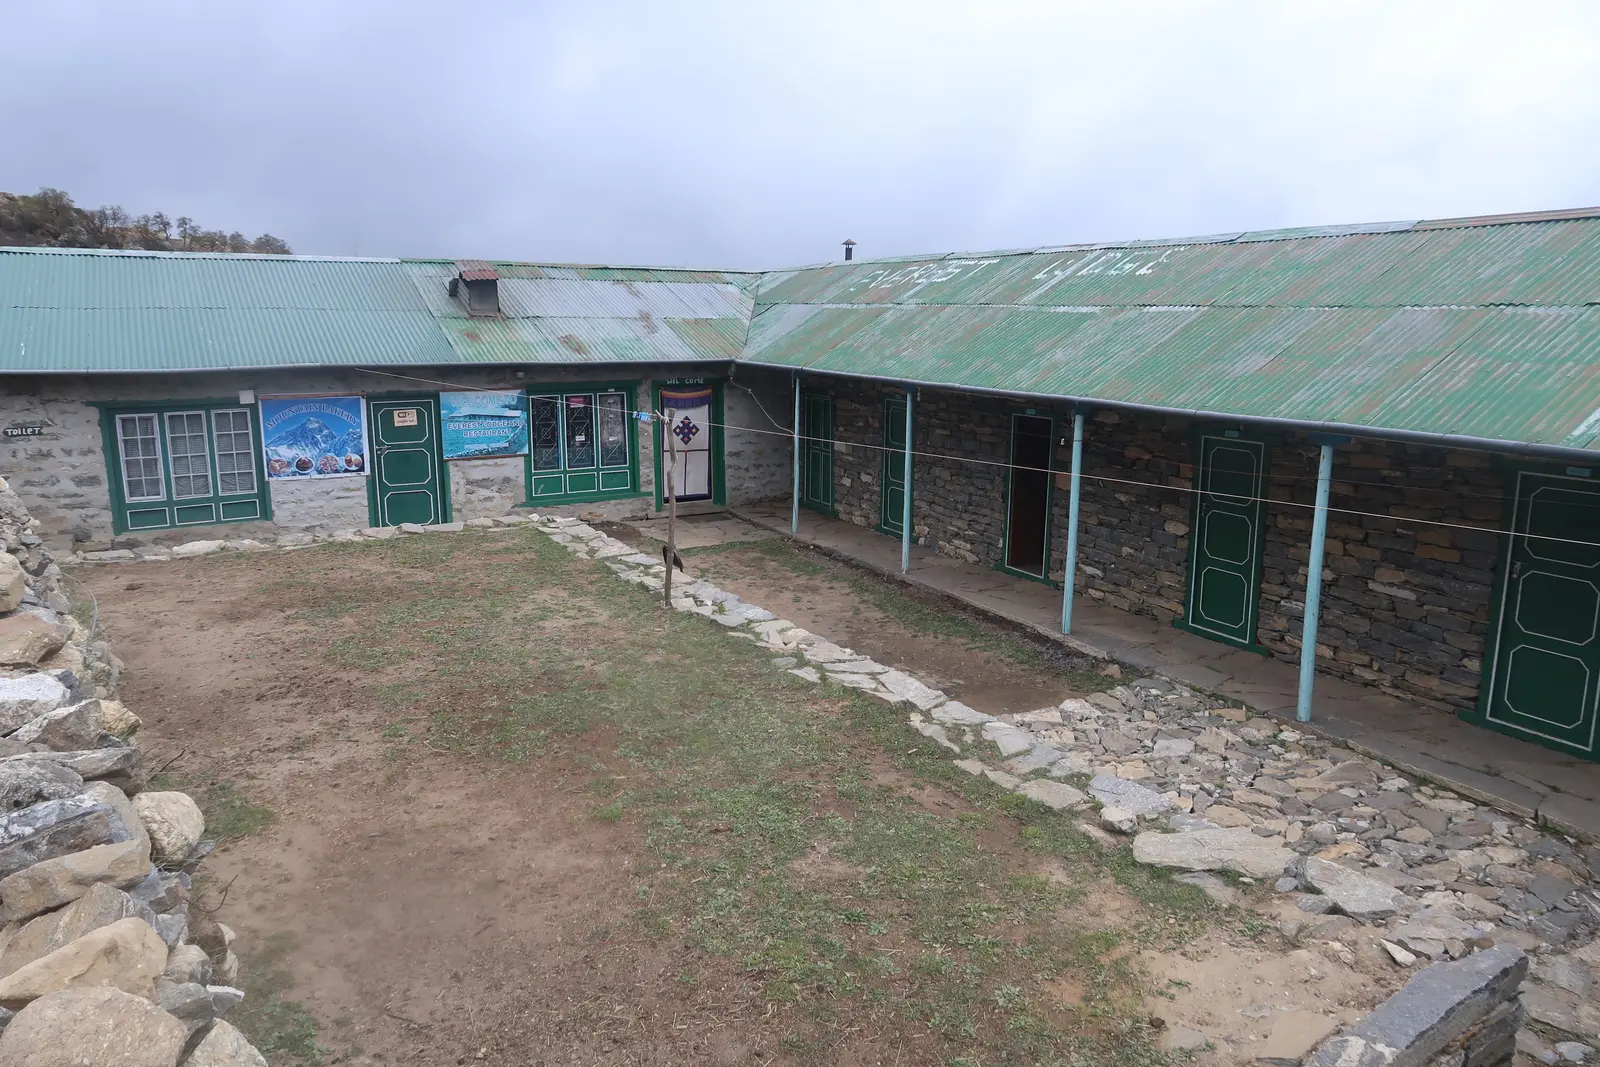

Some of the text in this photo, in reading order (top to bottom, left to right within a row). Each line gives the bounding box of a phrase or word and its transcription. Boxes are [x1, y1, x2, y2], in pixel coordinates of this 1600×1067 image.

[451, 394, 504, 408] WELCOME
[265, 403, 360, 430] MOUNTAIN BAKERY
[447, 419, 525, 431] EVEREST LODGE AND
[463, 428, 512, 438] RESTAURANT
